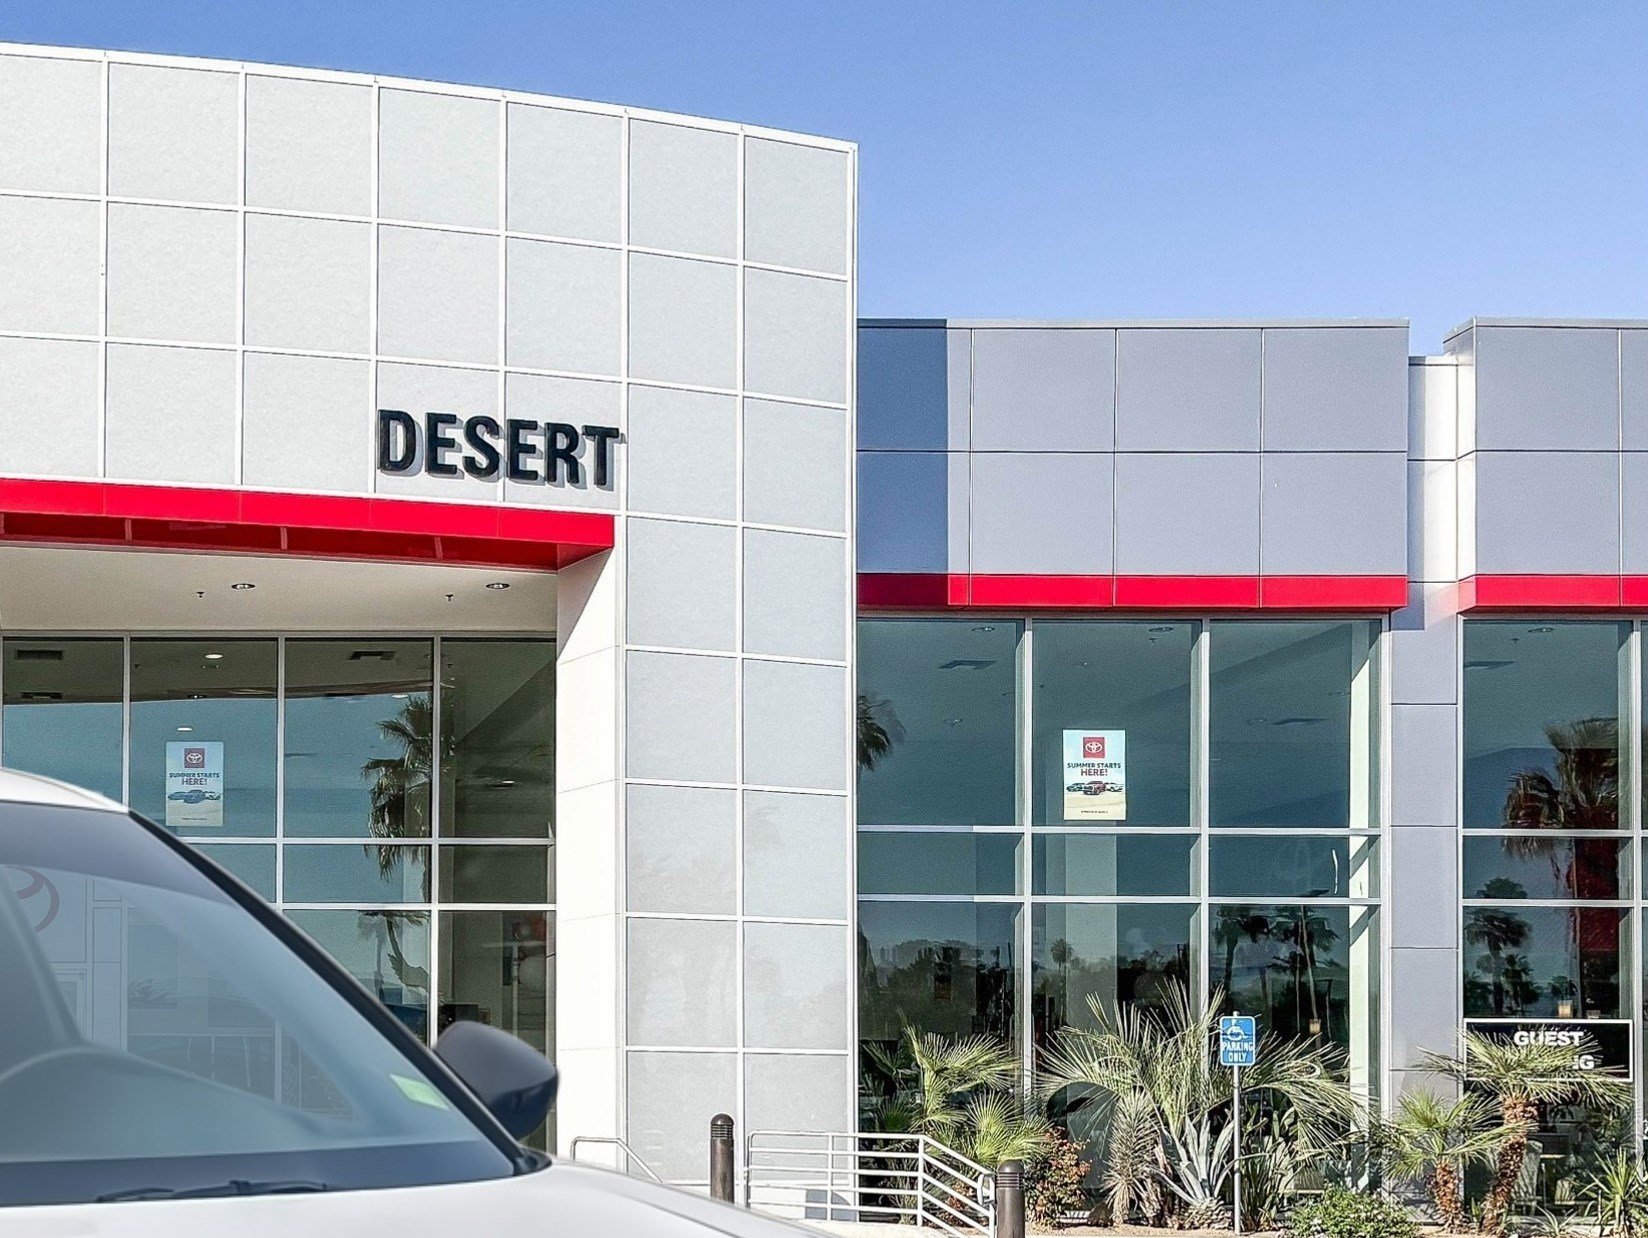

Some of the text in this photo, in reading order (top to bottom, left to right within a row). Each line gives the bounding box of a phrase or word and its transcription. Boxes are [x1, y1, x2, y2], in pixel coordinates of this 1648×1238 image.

[377, 409, 620, 486] DESERT
[1514, 1031, 1584, 1046] GUEST
[1222, 1042, 1253, 1051] PARKING
[1228, 1052, 1247, 1062] ONLY
